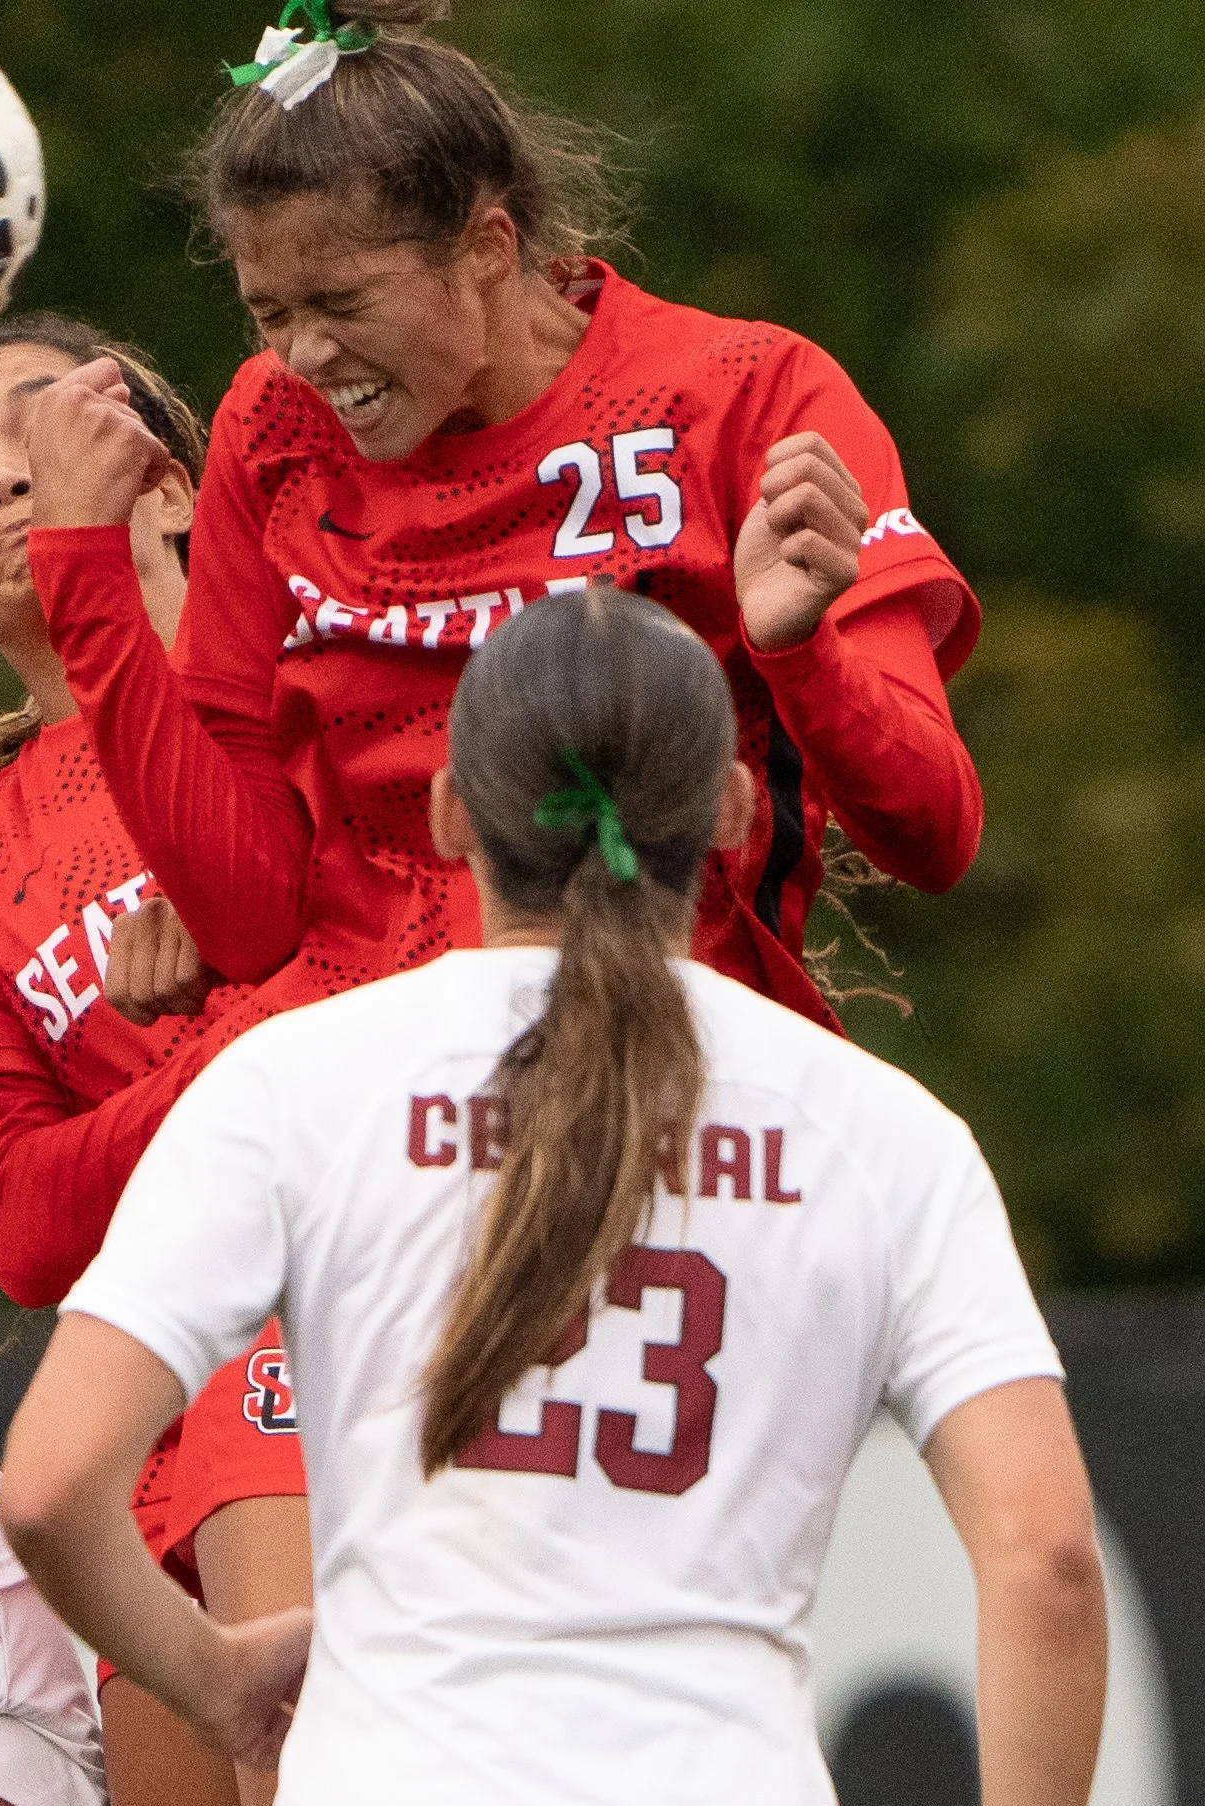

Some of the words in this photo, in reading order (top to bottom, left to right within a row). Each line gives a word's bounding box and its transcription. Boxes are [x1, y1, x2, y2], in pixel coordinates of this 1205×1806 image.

[536, 427, 683, 560] 25
[282, 574, 589, 650] SEATT
[407, 1095, 802, 1205] CERAL
